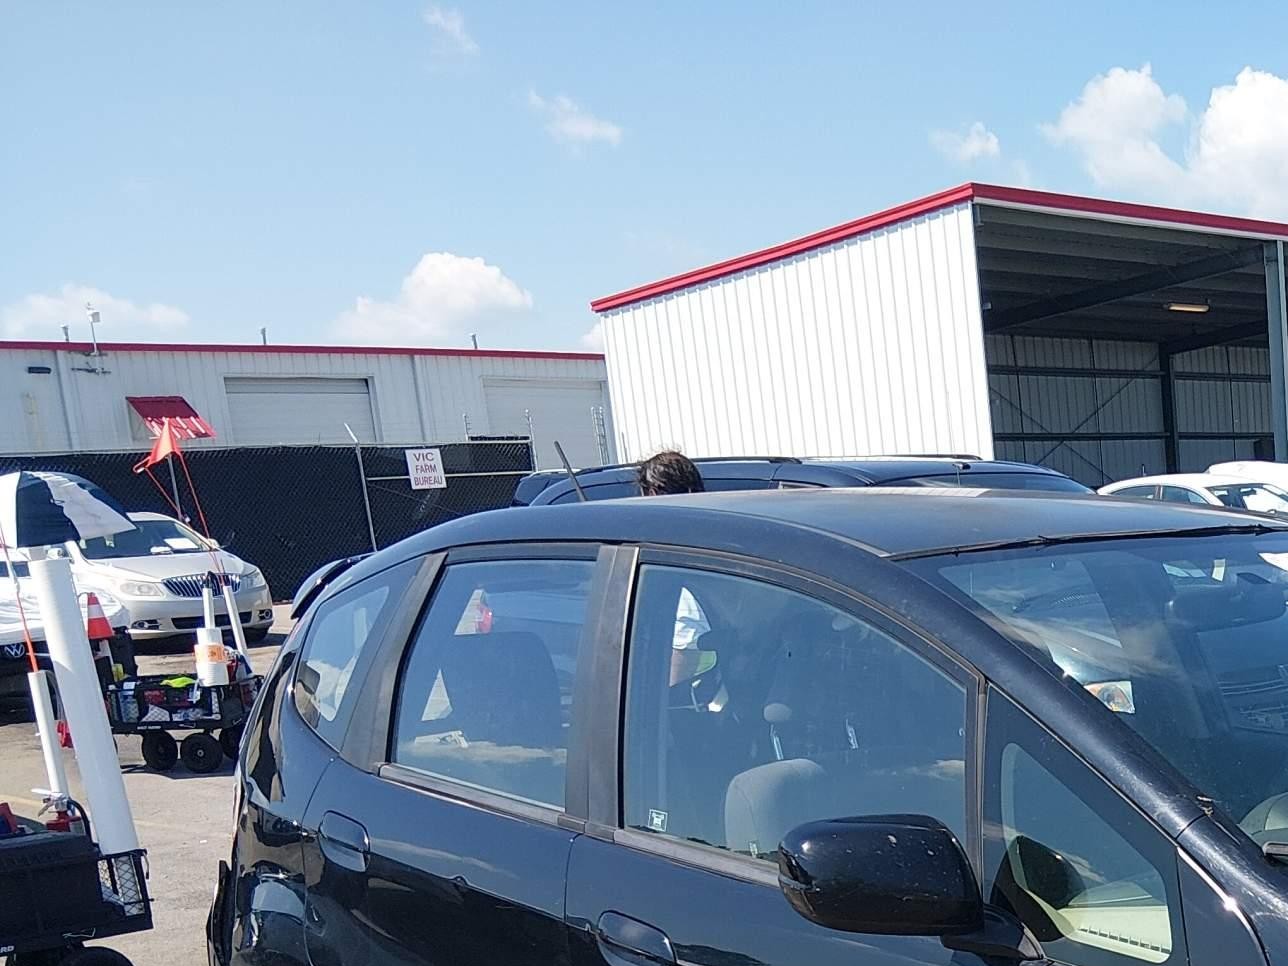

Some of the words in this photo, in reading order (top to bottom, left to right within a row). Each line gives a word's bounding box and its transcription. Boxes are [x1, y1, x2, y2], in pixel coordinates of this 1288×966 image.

[413, 452, 434, 462] VIC
[415, 463, 437, 474] FARM
[414, 475, 442, 486] BUREAU
